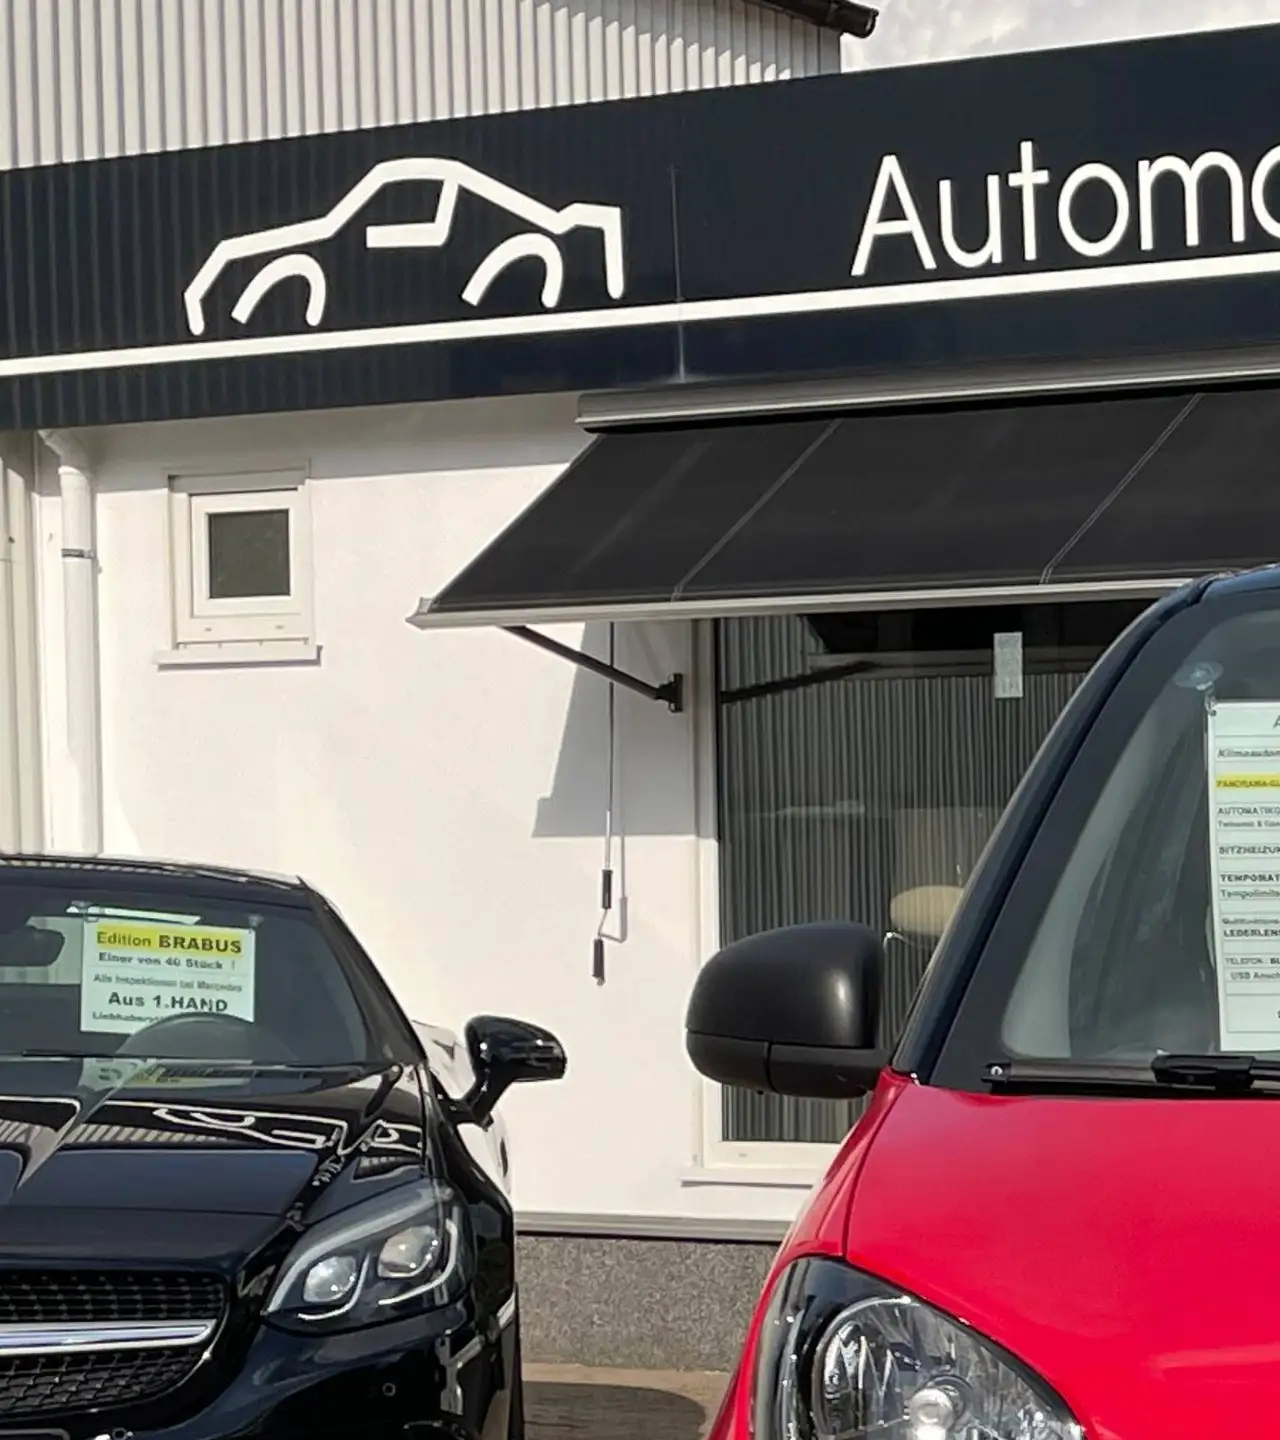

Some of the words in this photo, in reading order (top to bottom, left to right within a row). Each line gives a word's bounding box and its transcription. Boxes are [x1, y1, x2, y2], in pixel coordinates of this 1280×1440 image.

[97, 931, 151, 947] Edition
[158, 934, 242, 954] BRABUS
[108, 991, 145, 1006] Aus
